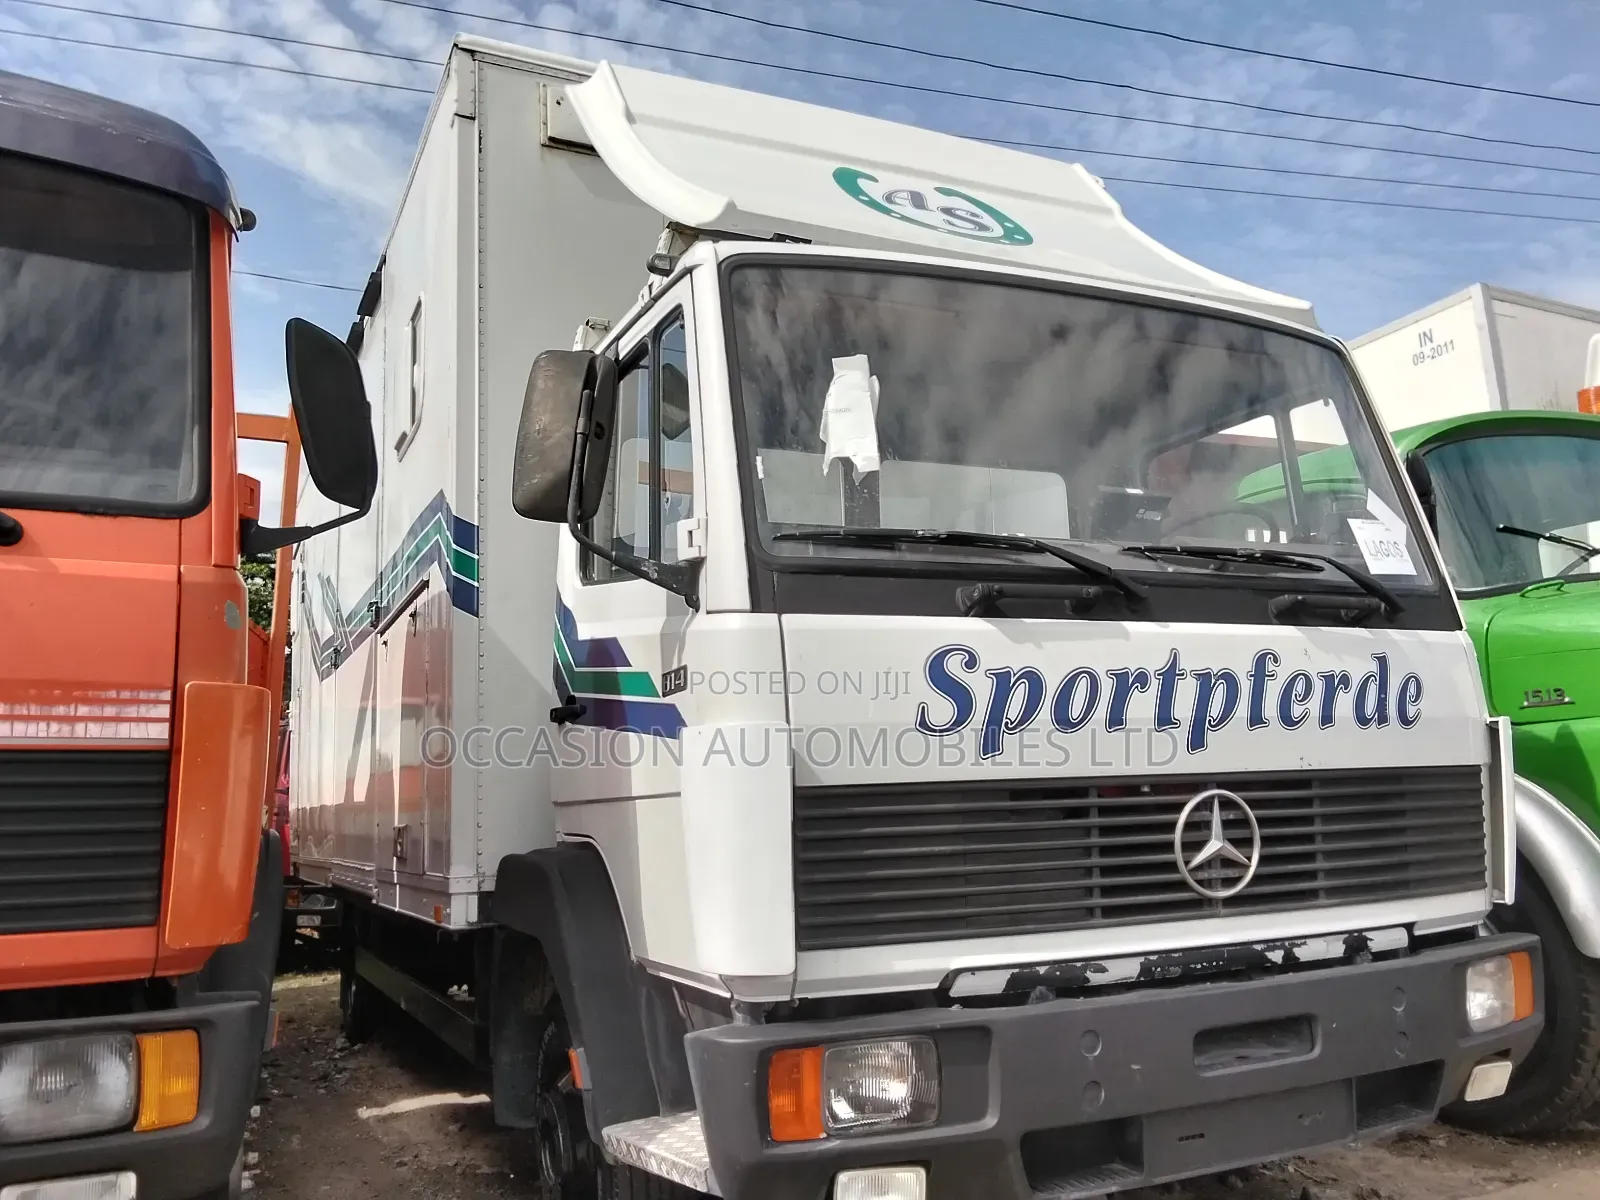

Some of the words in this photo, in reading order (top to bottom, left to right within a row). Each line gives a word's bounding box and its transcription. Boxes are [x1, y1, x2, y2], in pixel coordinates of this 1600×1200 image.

[1418, 328, 1434, 348] IN
[1411, 339, 1455, 366] 09-2011
[1364, 539, 1404, 559] LAGOS
[662, 669, 686, 693] 814
[914, 643, 1424, 760] Sportpferde
[1523, 687, 1566, 702] 1513
